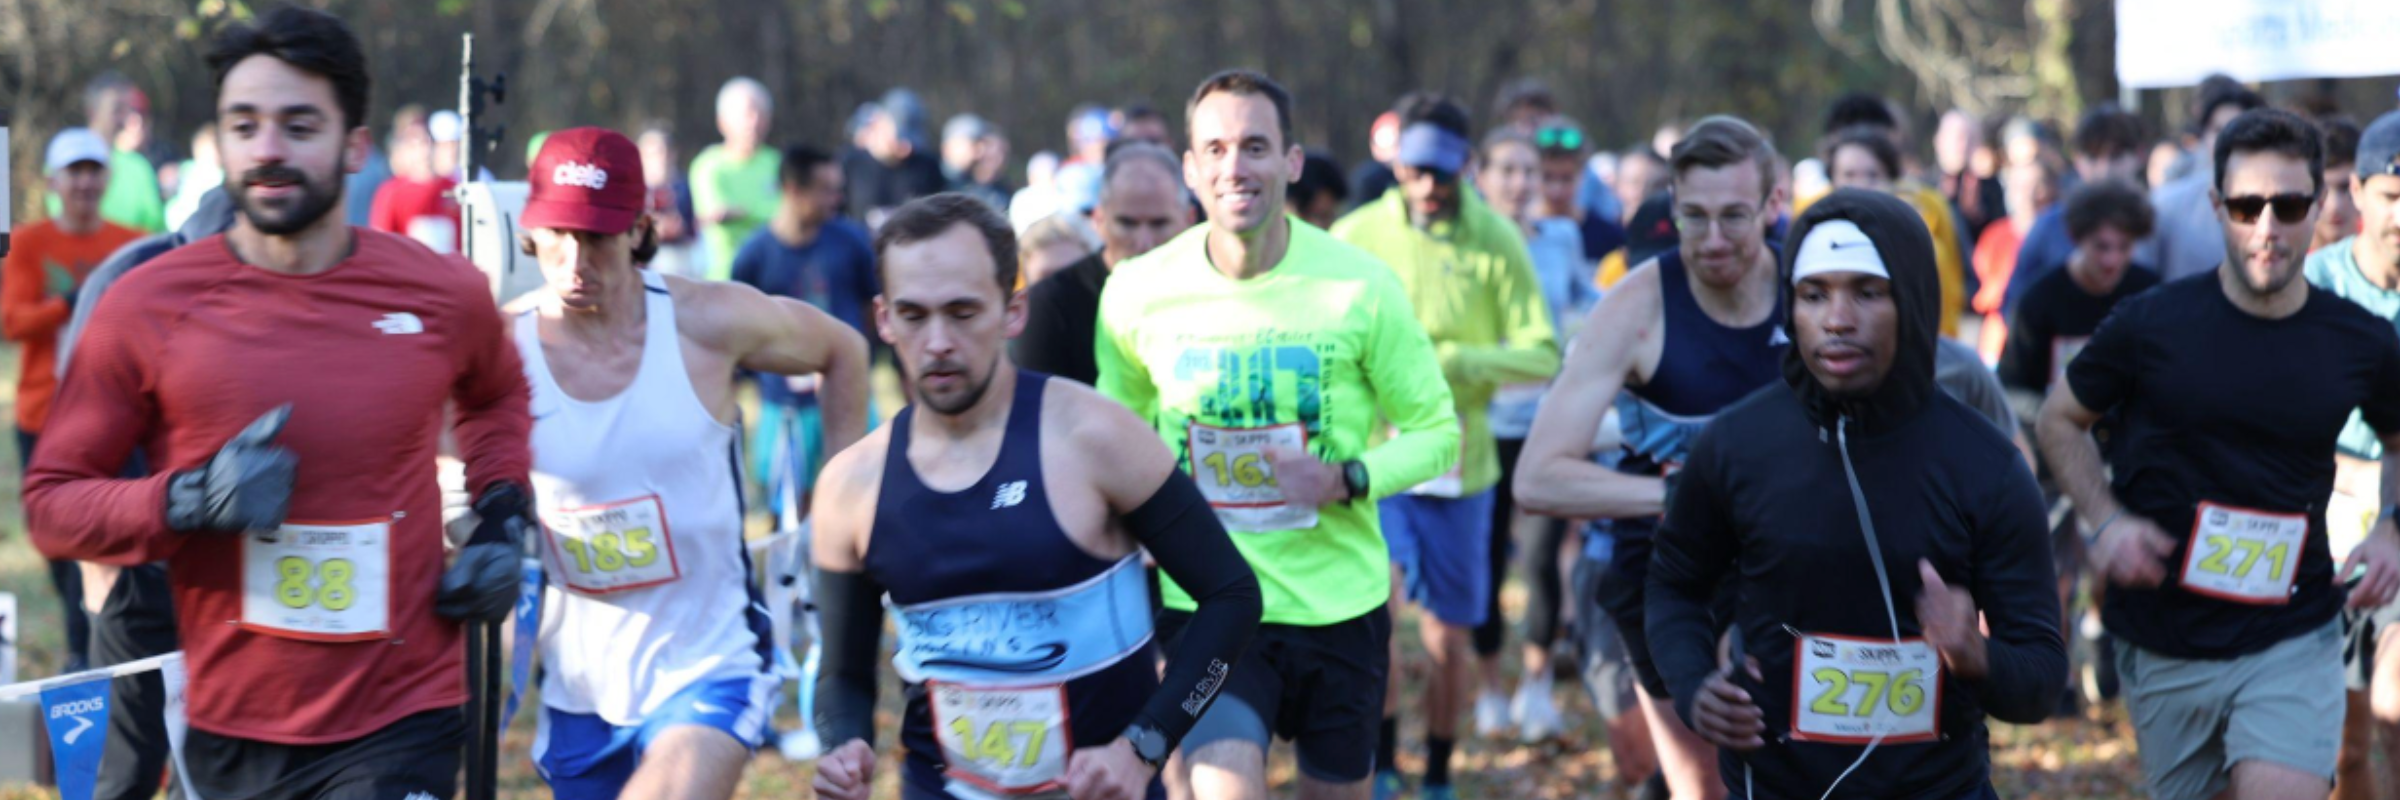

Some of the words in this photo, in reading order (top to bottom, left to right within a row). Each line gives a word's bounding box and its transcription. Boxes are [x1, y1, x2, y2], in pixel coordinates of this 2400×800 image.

[563, 526, 659, 574] 185
[2197, 535, 2290, 582] 271
[273, 555, 357, 611] 88
[961, 601, 1060, 635] RIVER
[51, 696, 104, 719] BROOKS
[1810, 666, 1925, 718] 276
[950, 715, 1048, 769] 147
